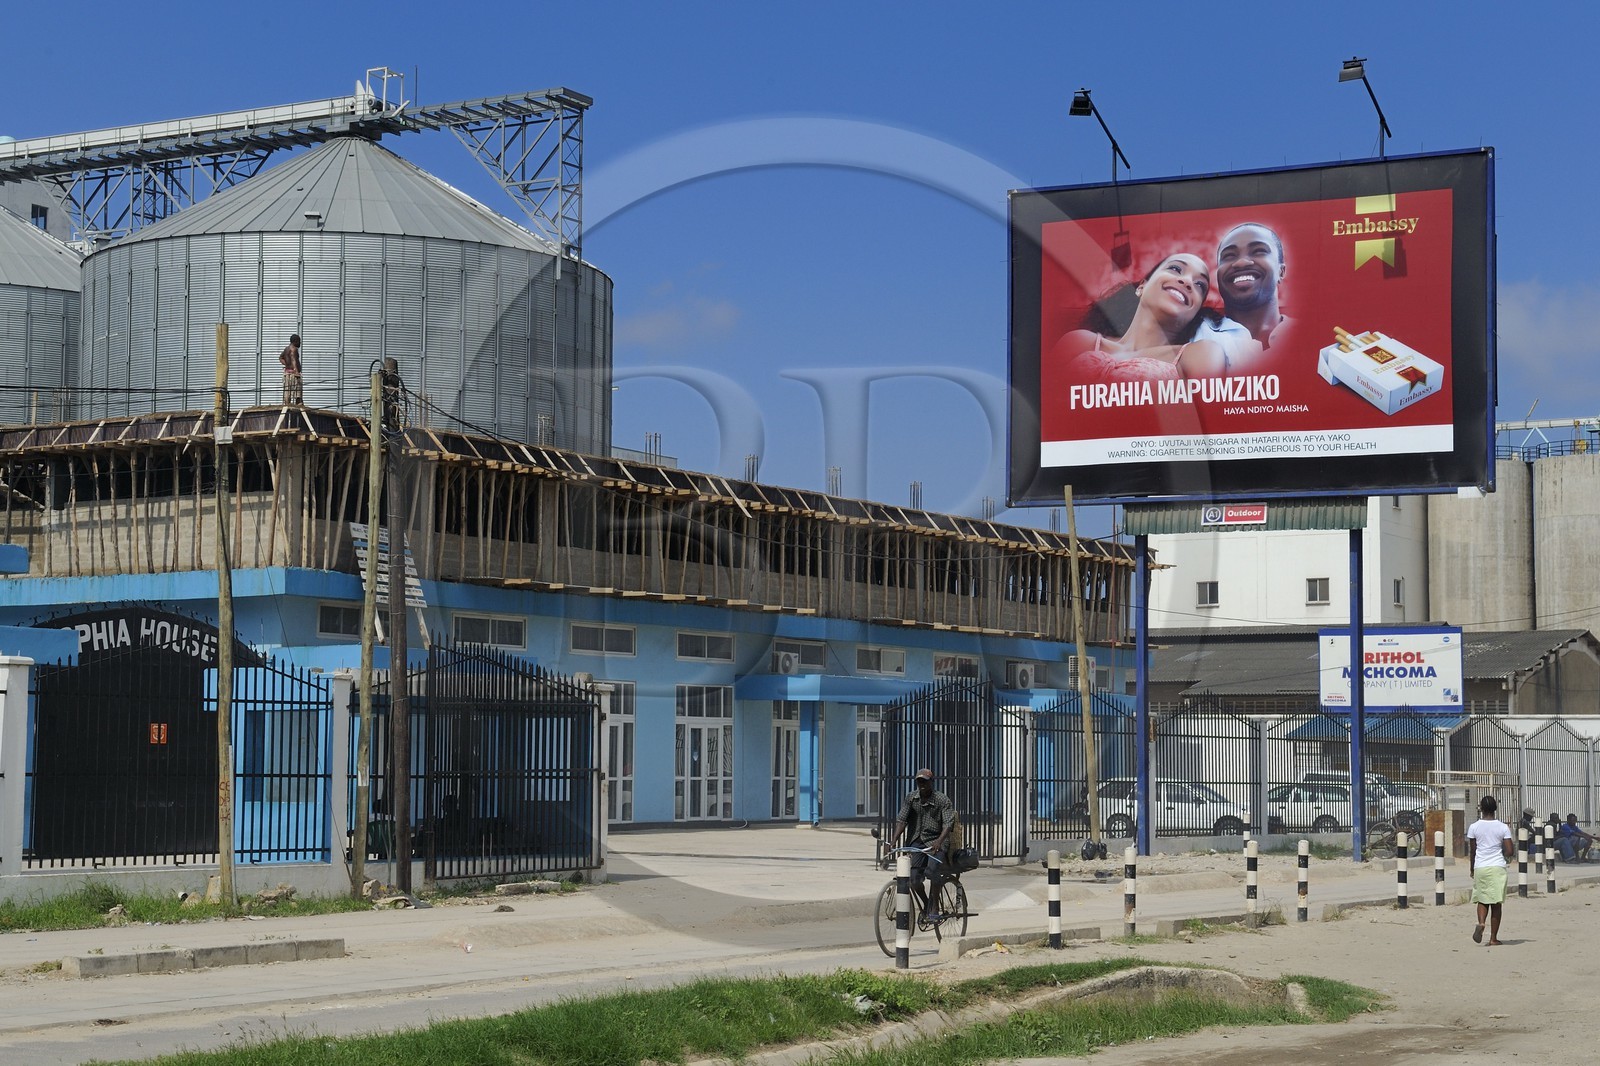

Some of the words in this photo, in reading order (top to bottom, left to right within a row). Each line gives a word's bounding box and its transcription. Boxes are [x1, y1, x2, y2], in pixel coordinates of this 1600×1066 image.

[1332, 217, 1419, 236] Embassy
[1070, 380, 1154, 410] FURAHIA
[1158, 374, 1280, 404] MAPUMZIKO
[1356, 375, 1384, 400] Embassy
[1399, 385, 1433, 406] Embassy
[1224, 406, 1246, 415] HAYA
[1247, 405, 1274, 414] NDIYO
[1276, 404, 1309, 413] MAISHA
[1159, 439, 1192, 447] UVUTAJI
[1251, 436, 1280, 444] HATARI
[1303, 434, 1326, 442] AFYA
[1327, 433, 1351, 441] YAKO
[1108, 450, 1148, 458] WARNING:
[1149, 448, 1194, 457] CIGARETTE
[1196, 447, 1235, 455] SMOKING
[1237, 446, 1246, 454] IS
[1248, 445, 1301, 453] DANGEROUS
[1316, 443, 1342, 451] YOUR
[1344, 442, 1377, 450] HEALTH
[1227, 509, 1262, 517] Outdoor
[61, 618, 131, 653] PHIA
[140, 618, 218, 662] HOUSE
[1364, 651, 1425, 664] RITHOL
[1342, 665, 1437, 679] MCHCOMA
